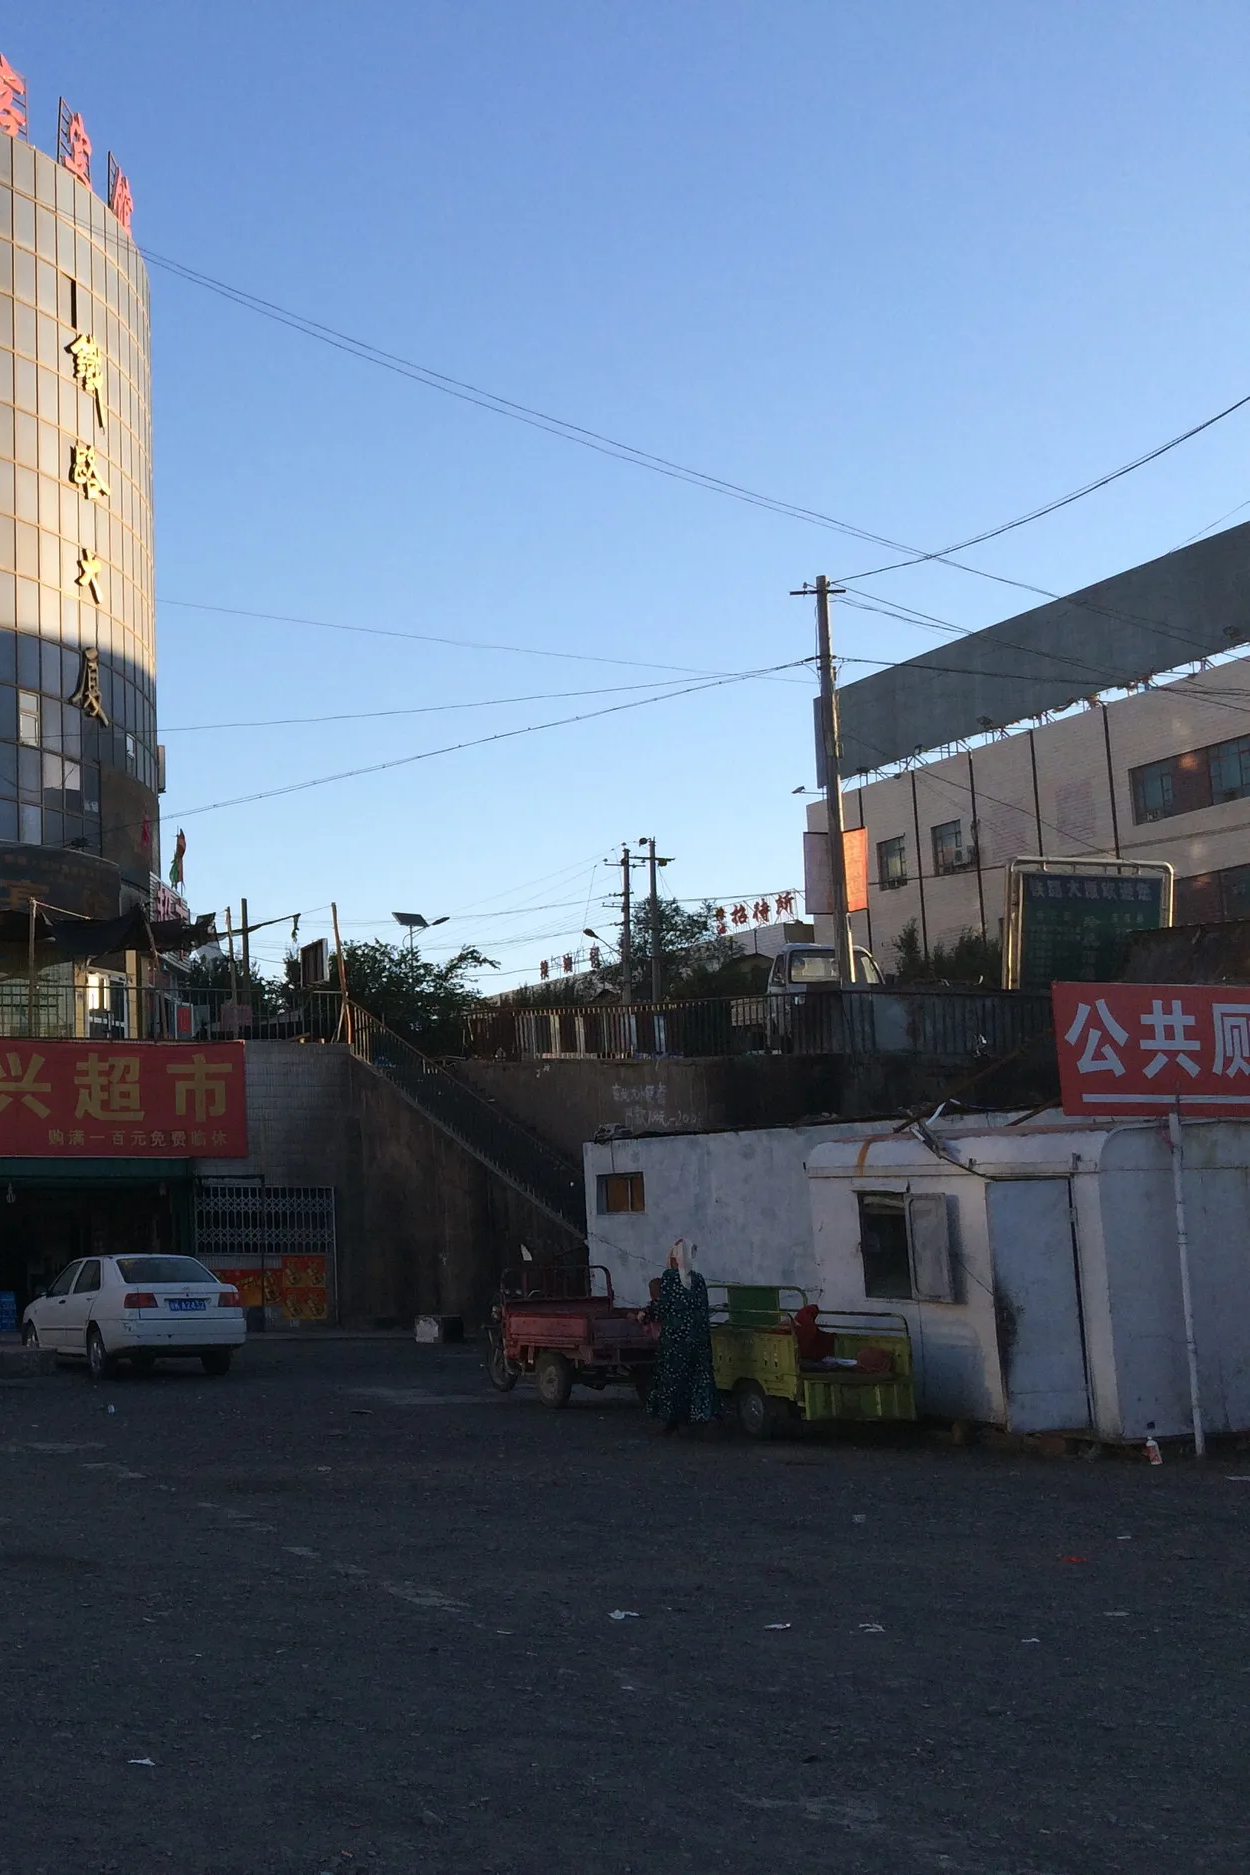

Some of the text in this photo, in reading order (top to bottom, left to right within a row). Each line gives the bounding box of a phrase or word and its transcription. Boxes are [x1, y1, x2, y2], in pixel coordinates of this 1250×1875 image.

[729, 891, 795, 926] 招待所
[1064, 999, 1250, 1079] 公共厕
